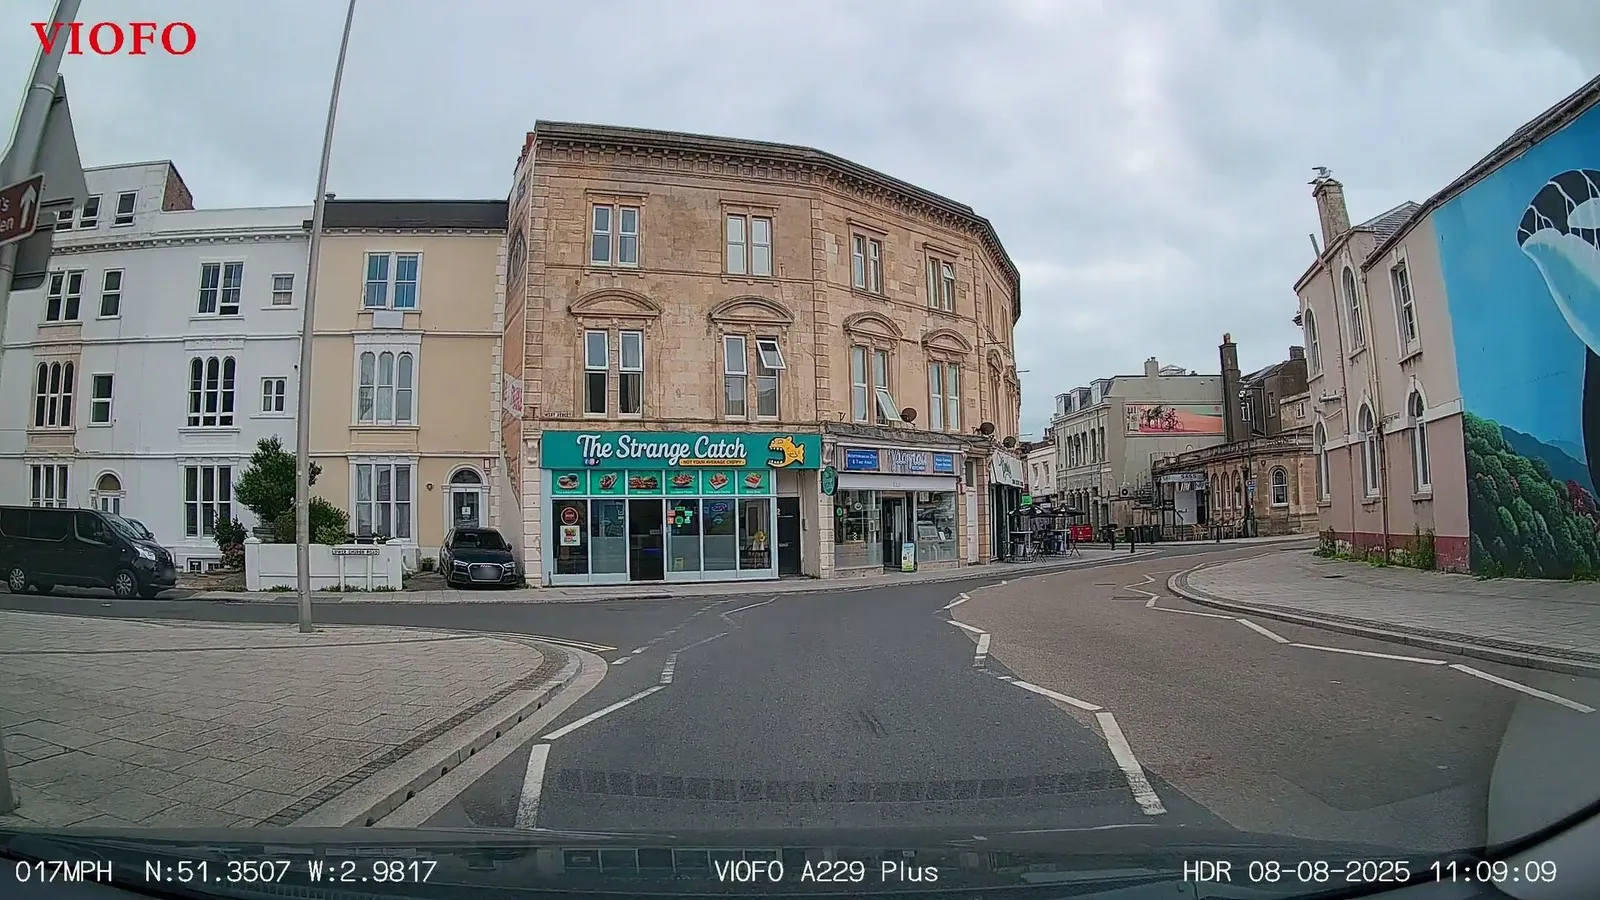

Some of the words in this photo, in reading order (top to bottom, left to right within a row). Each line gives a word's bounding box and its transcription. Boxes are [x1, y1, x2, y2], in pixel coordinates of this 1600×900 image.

[576, 434, 613, 458] The
[615, 434, 691, 466] Strange
[694, 435, 748, 459] Catch
